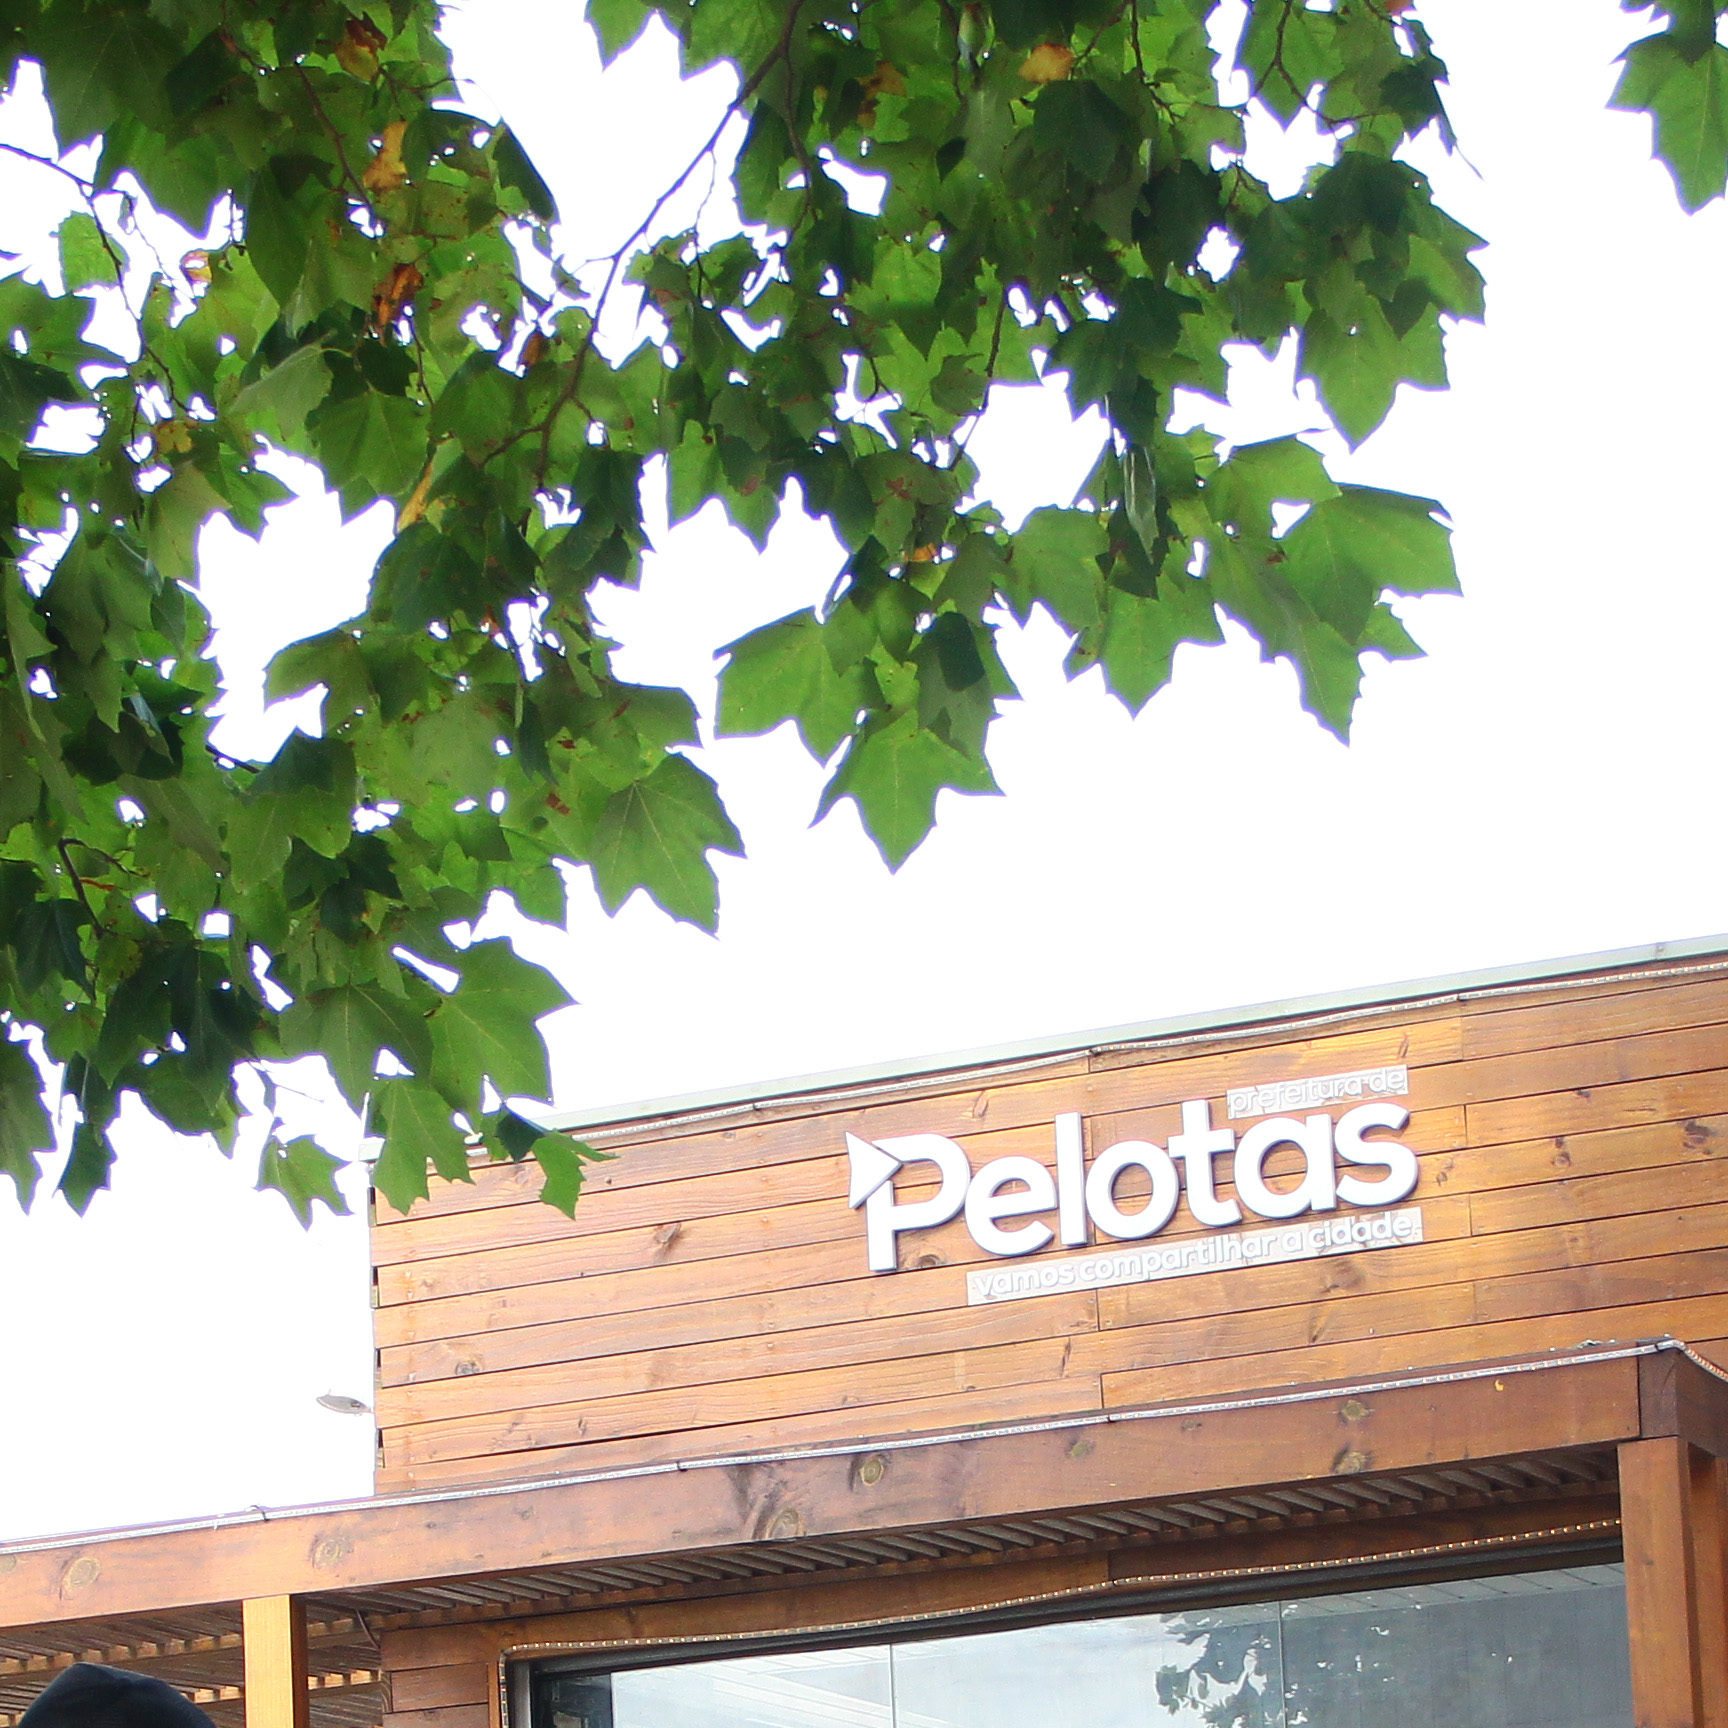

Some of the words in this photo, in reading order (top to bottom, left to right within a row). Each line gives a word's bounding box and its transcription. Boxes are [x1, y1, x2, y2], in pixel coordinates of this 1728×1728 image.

[1229, 1077, 1362, 1119] prefeitura
[1368, 1068, 1405, 1093] de
[846, 1099, 1420, 1273] Pelotas
[974, 1262, 1074, 1298] vamos
[1079, 1229, 1279, 1281] compartilhar
[1281, 1230, 1302, 1252] a
[1307, 1212, 1413, 1249] cidade
